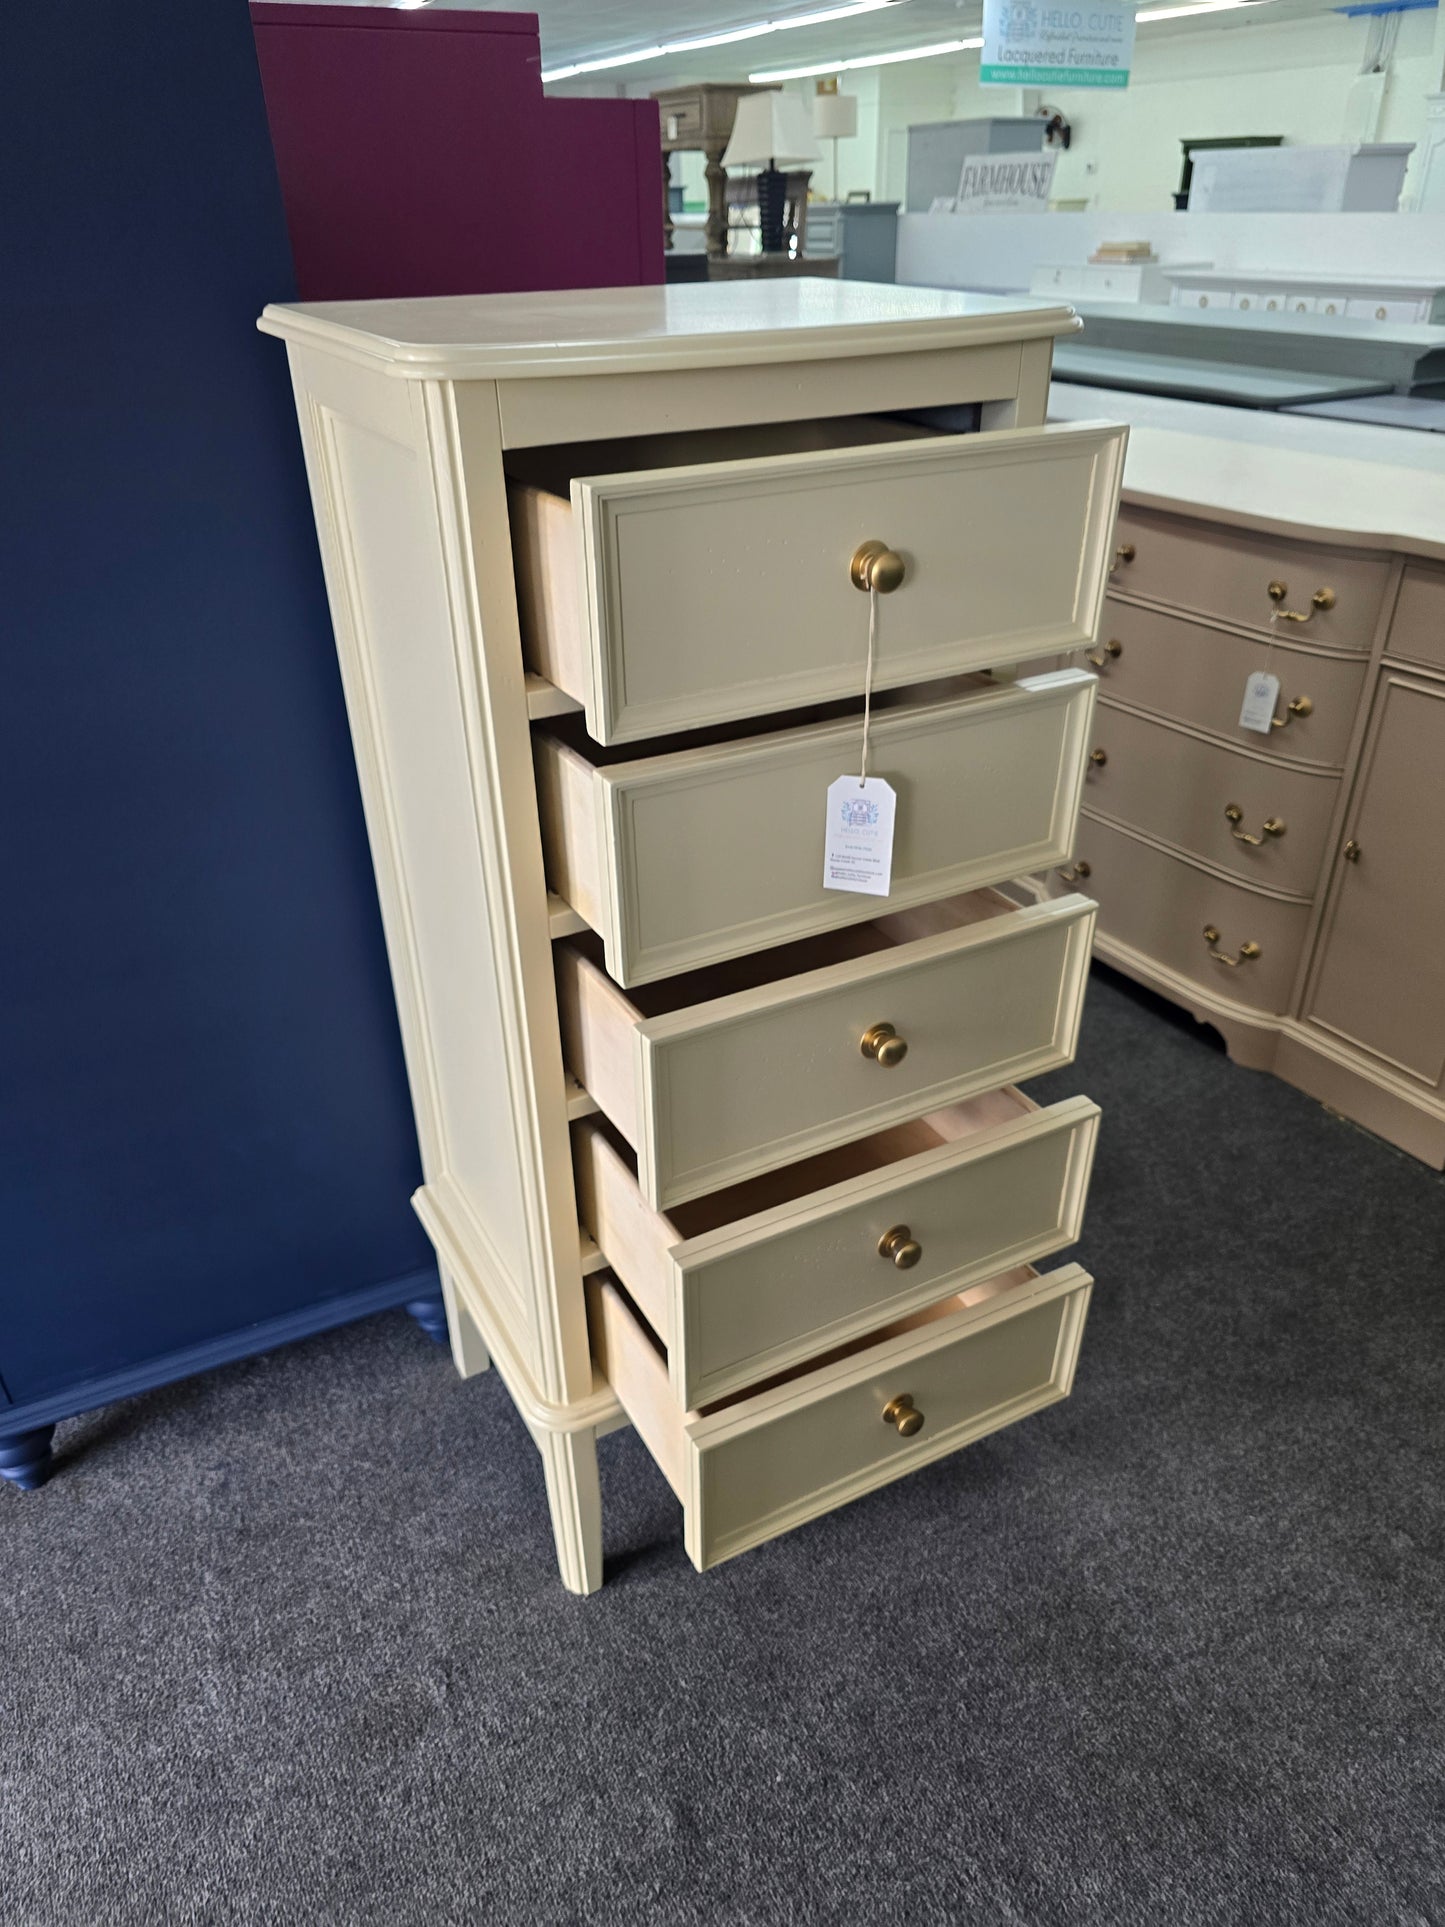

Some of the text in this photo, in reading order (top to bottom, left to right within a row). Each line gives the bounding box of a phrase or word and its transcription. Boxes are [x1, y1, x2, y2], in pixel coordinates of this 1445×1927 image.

[998, 46, 1120, 67] Lacquered Furniture
[960, 163, 1051, 202] FARMHOUSE
